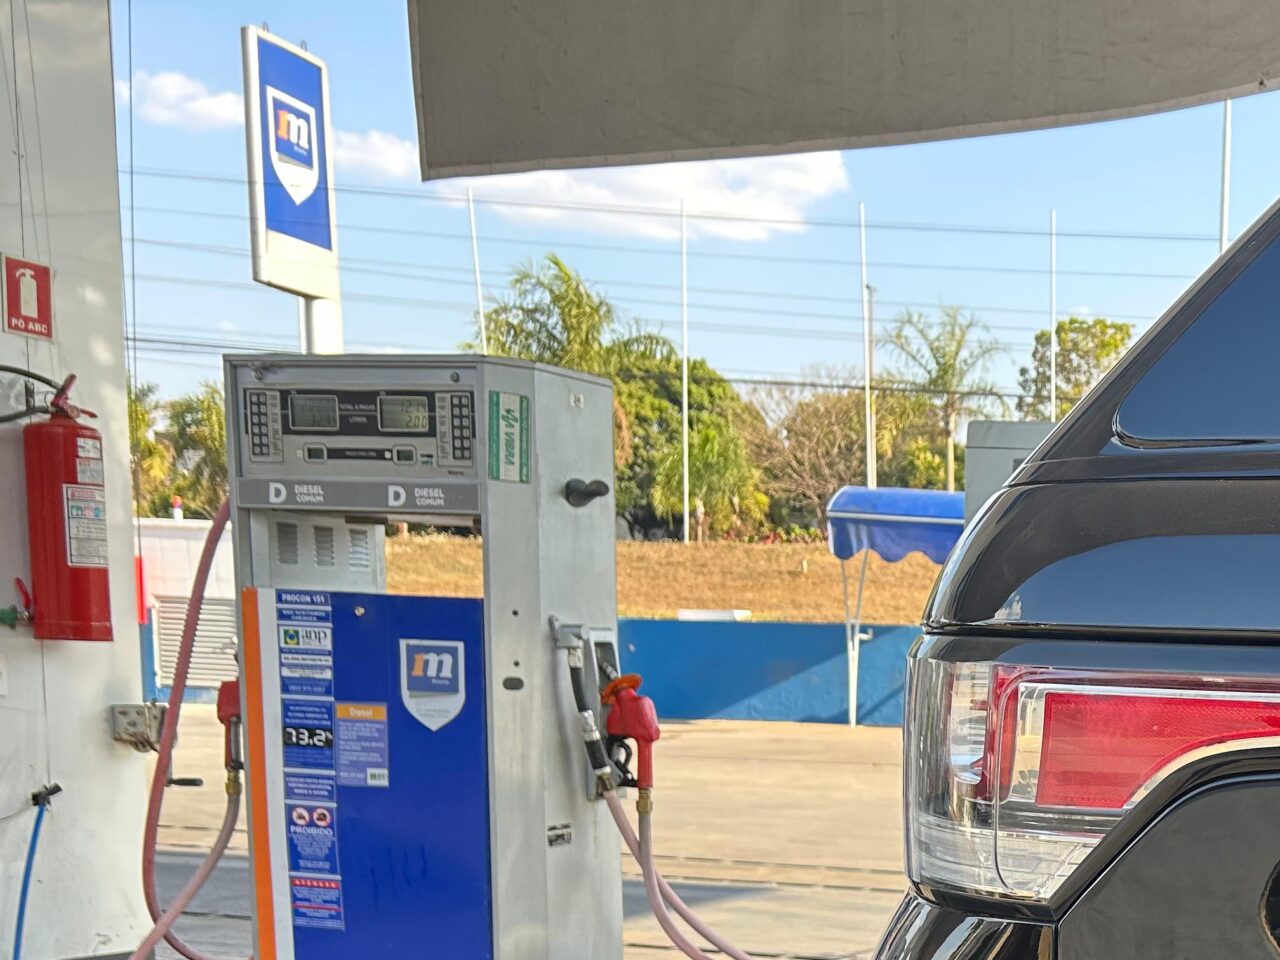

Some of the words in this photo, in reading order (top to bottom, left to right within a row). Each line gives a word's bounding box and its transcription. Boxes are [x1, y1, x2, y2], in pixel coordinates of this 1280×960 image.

[11, 316, 25, 329] PÓ
[28, 321, 48, 334] ABC
[504, 432, 515, 466] VIBRA
[269, 482, 287, 503] D
[294, 484, 324, 495] DIESEL
[414, 488, 445, 497] DIESEL
[296, 494, 324, 504] COMUM
[388, 485, 407, 507] D
[416, 496, 445, 507] COMUM
[282, 593, 311, 603] PROCON
[290, 824, 334, 837] PROIBIDO
